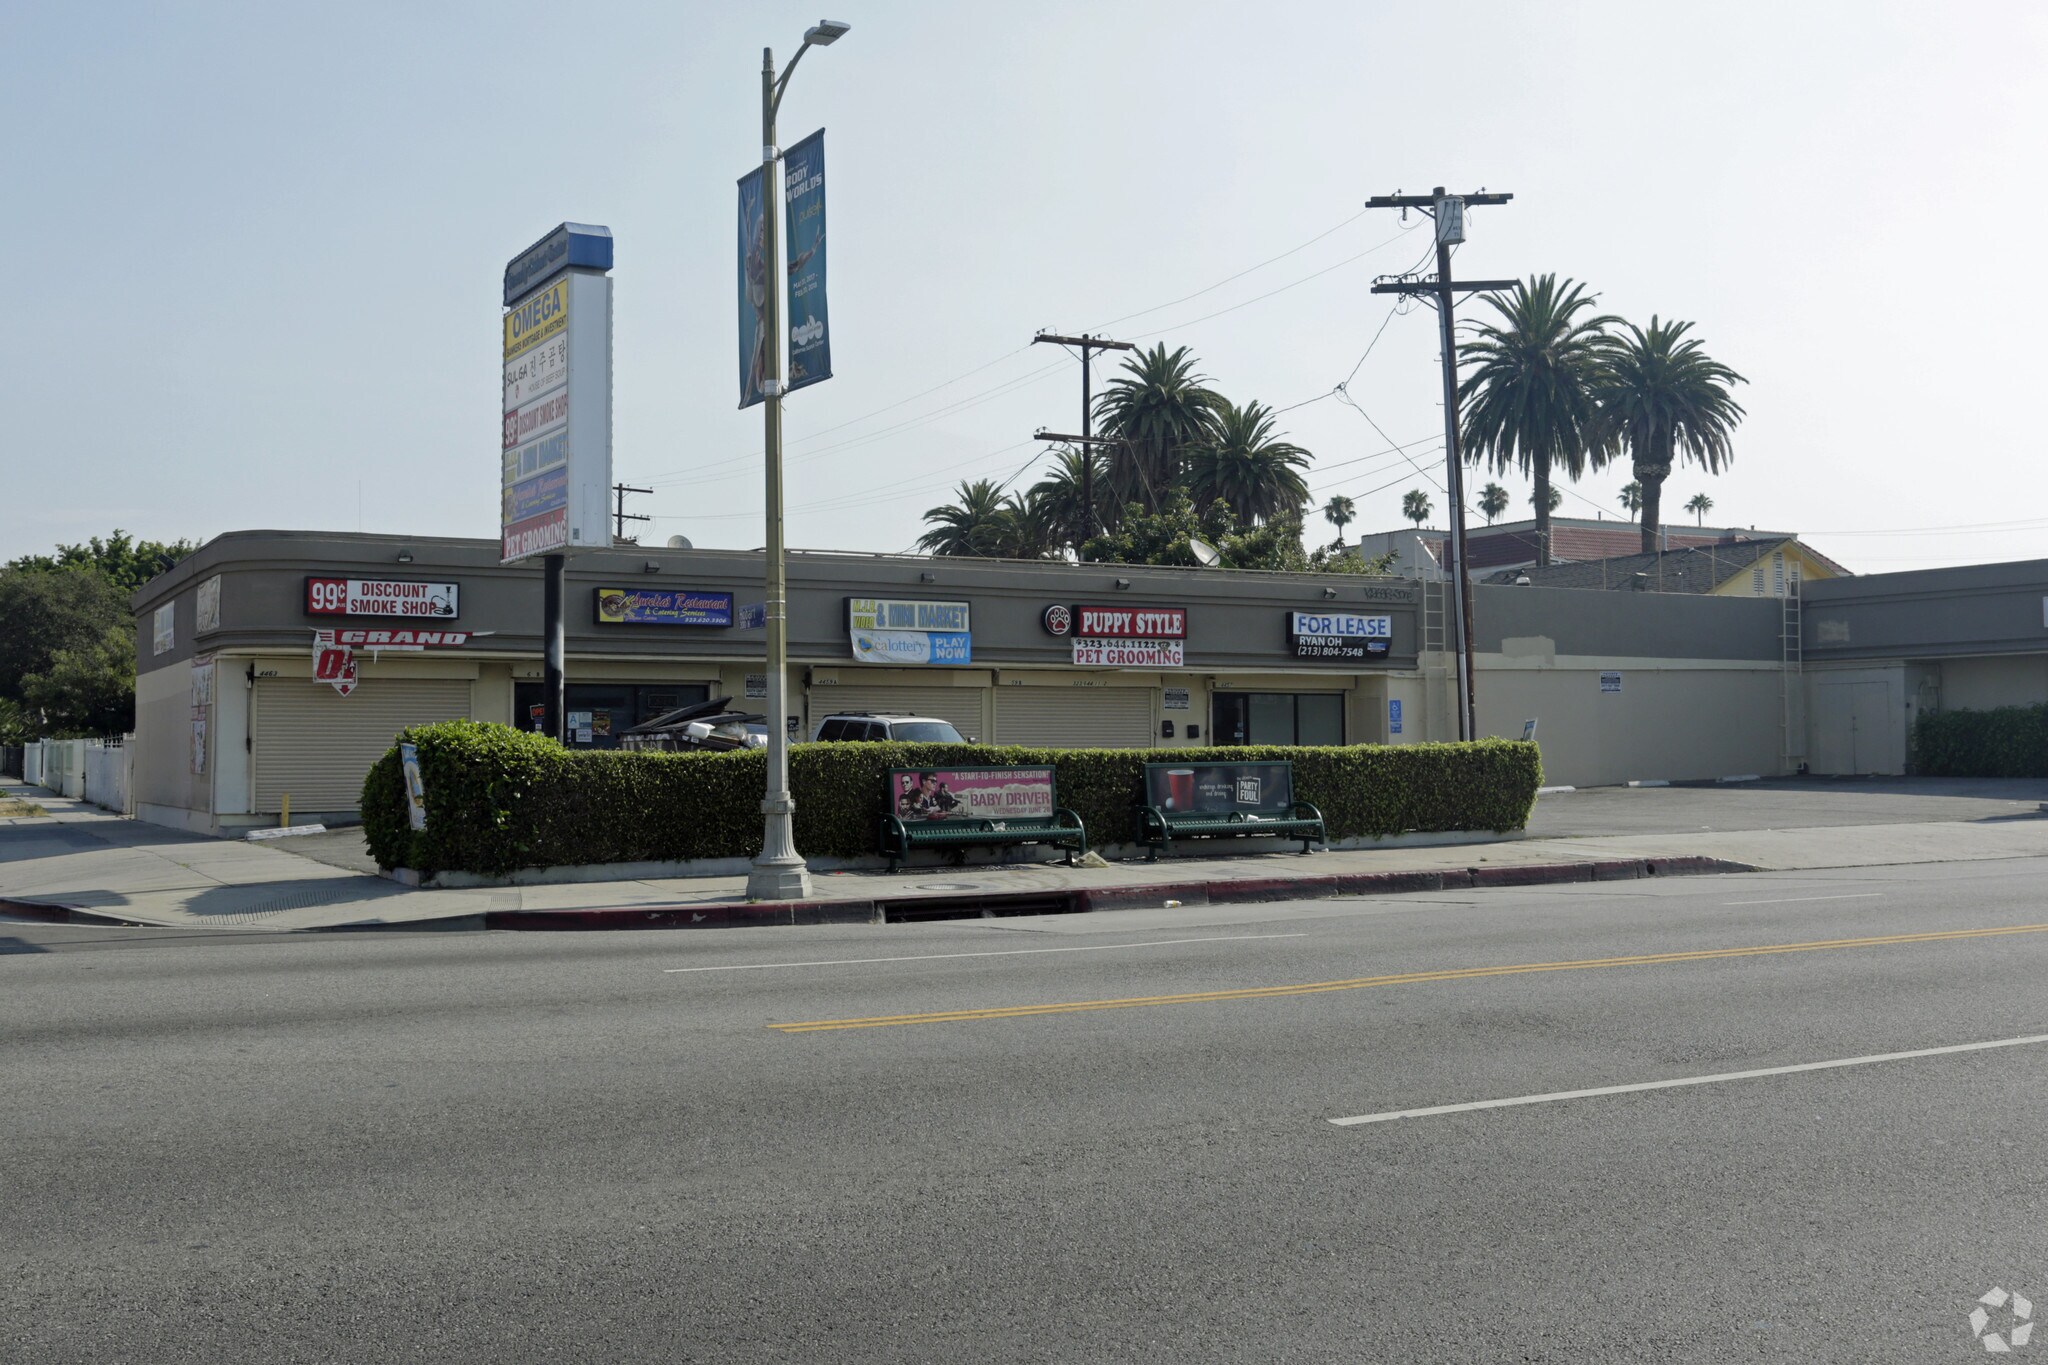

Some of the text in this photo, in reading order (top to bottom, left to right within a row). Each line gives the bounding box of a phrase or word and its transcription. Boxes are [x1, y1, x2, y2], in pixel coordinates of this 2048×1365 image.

[786, 165, 809, 188] BODY
[786, 173, 822, 203] WORLDS
[512, 287, 561, 339] OMEGA
[506, 534, 521, 558] PET
[521, 520, 566, 551] GROOMING
[361, 582, 428, 598] DISCOUNT
[350, 599, 436, 615] SMOKE SHOP
[675, 593, 728, 610] Restaurant
[652, 607, 679, 618] Catering
[680, 607, 706, 617] Services
[876, 603, 967, 629] & MINI MARKET
[1082, 612, 1182, 634] PUPPY STYLE
[1298, 616, 1386, 635] FOR LEASE
[340, 631, 468, 645] GRAND
[935, 638, 966, 648] PLAY
[1082, 640, 1156, 649] 323.644.1122
[1299, 636, 1342, 646] RYAN OH
[936, 648, 966, 659] NOW
[1075, 649, 1182, 665] PET GROOMING
[1297, 646, 1321, 656] (213)
[1322, 647, 1363, 656] 804-7548
[961, 772, 1012, 780] START-TO-FINISH
[1240, 781, 1258, 791] PARTY
[970, 792, 1002, 807] BABY
[1006, 791, 1050, 805] DRIVER
[1240, 790, 1258, 801] FOUL
[993, 807, 1027, 815] WEDNESDAY
